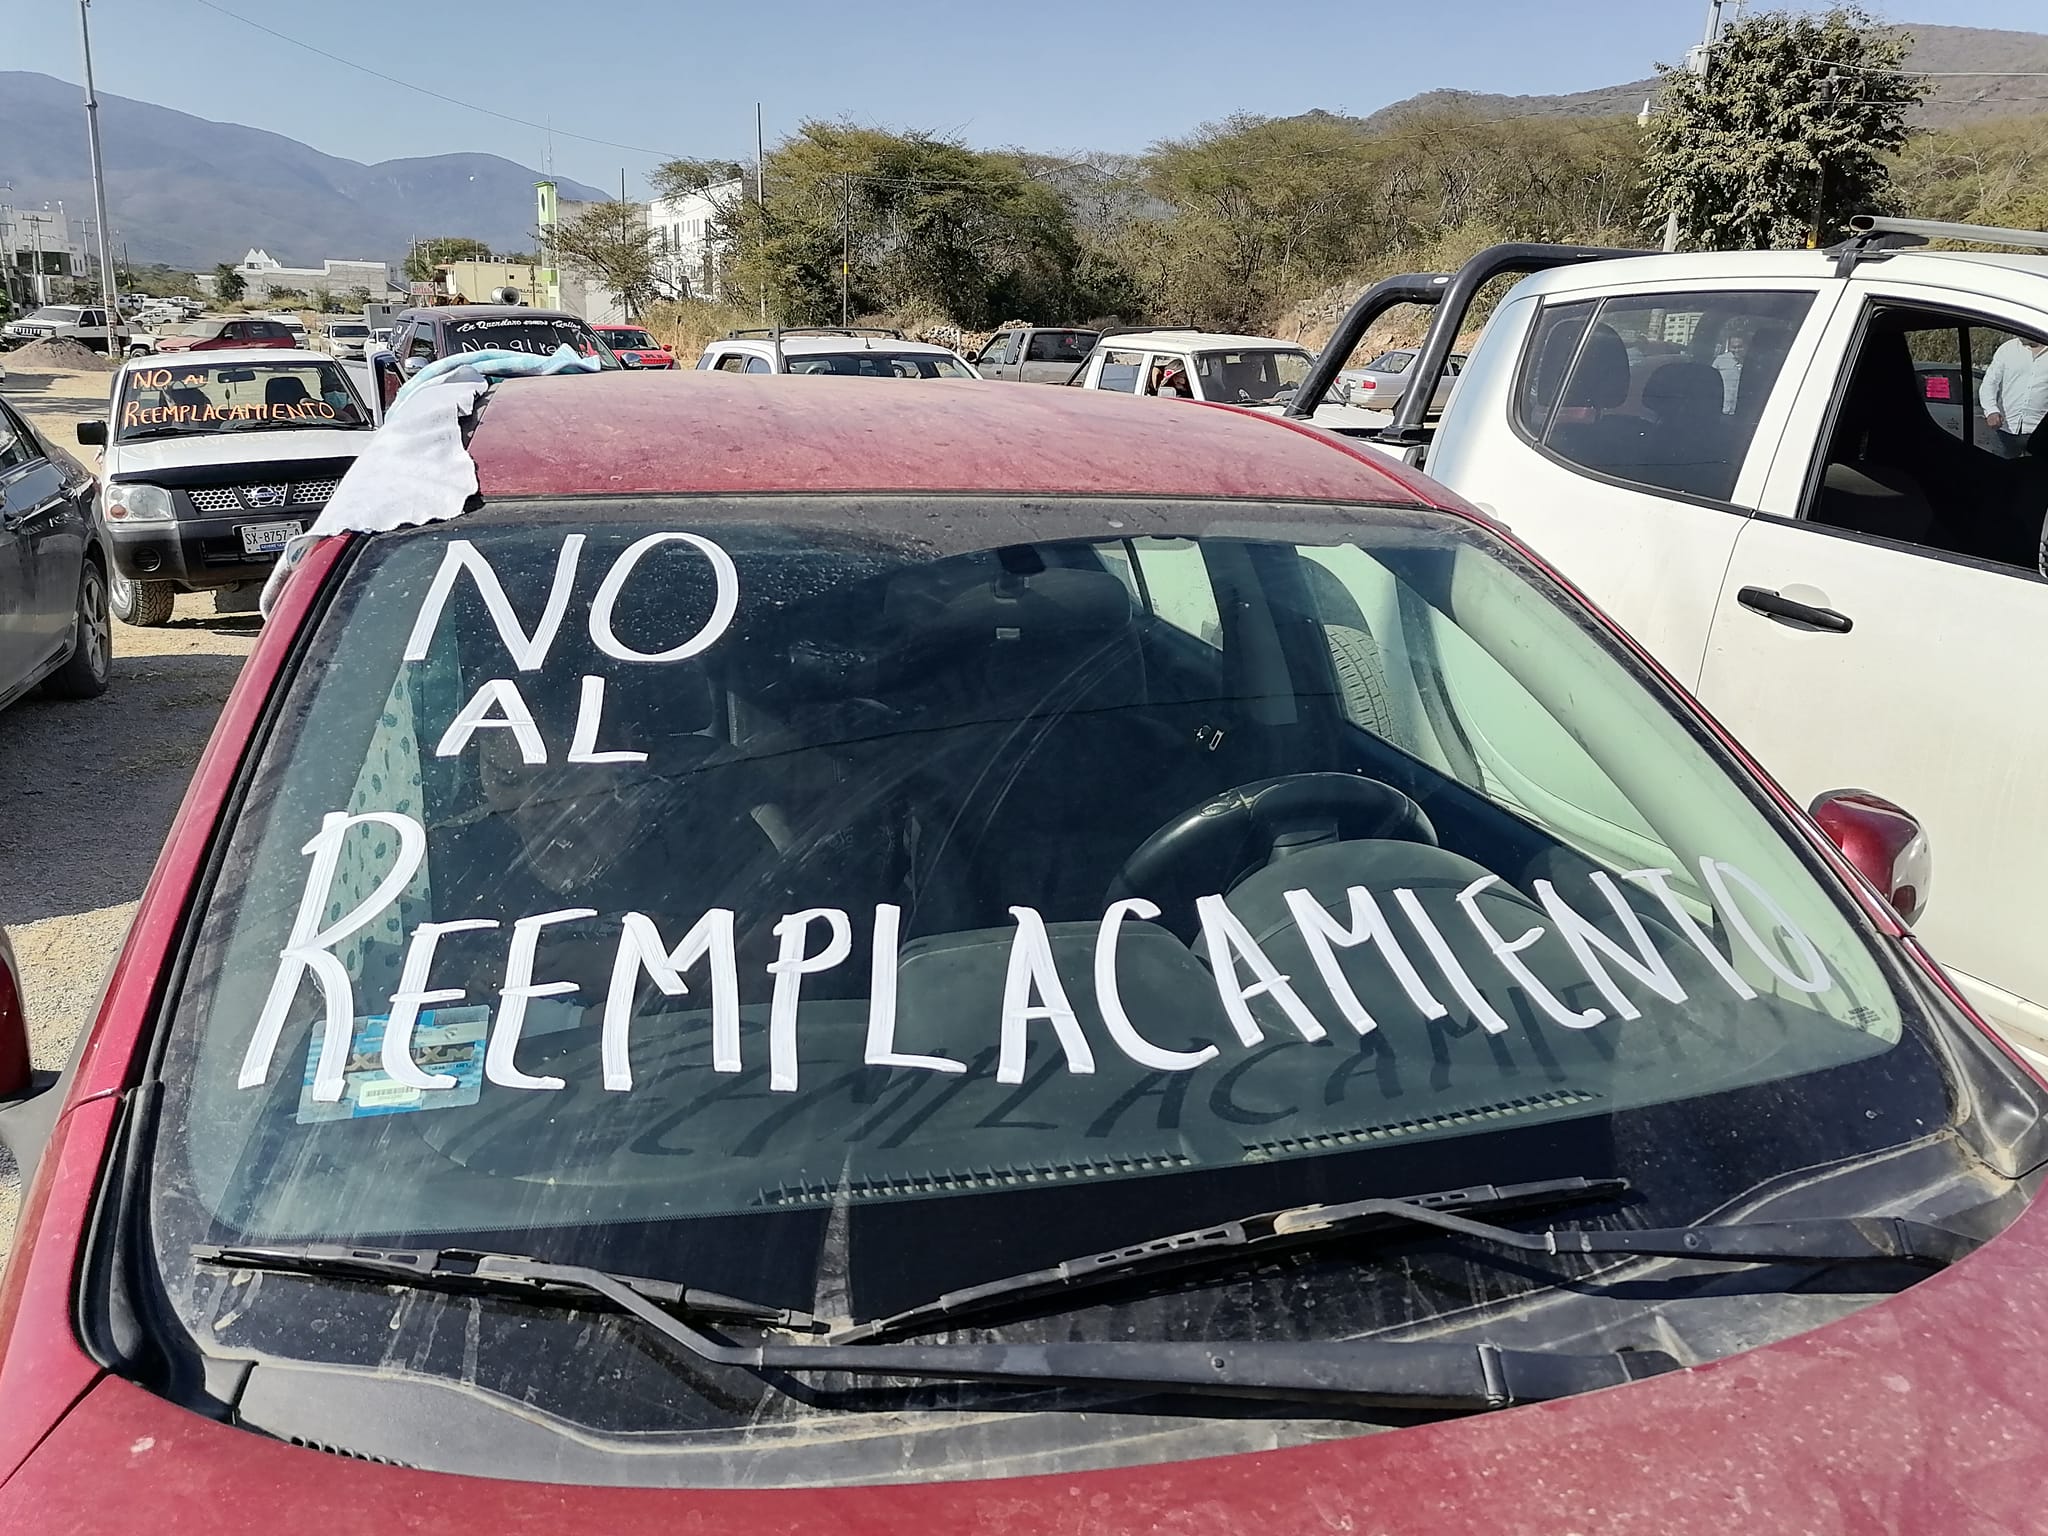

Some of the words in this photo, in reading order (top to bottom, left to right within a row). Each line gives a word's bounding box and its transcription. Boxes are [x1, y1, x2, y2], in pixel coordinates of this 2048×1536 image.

[124, 401, 336, 429] REEMPLACAMIENTO
[133, 369, 173, 390] NO
[183, 374, 209, 385] AL
[403, 531, 740, 671] NO
[435, 675, 648, 764] AL
[238, 811, 1832, 1102] REEMPLACAMIENTO
